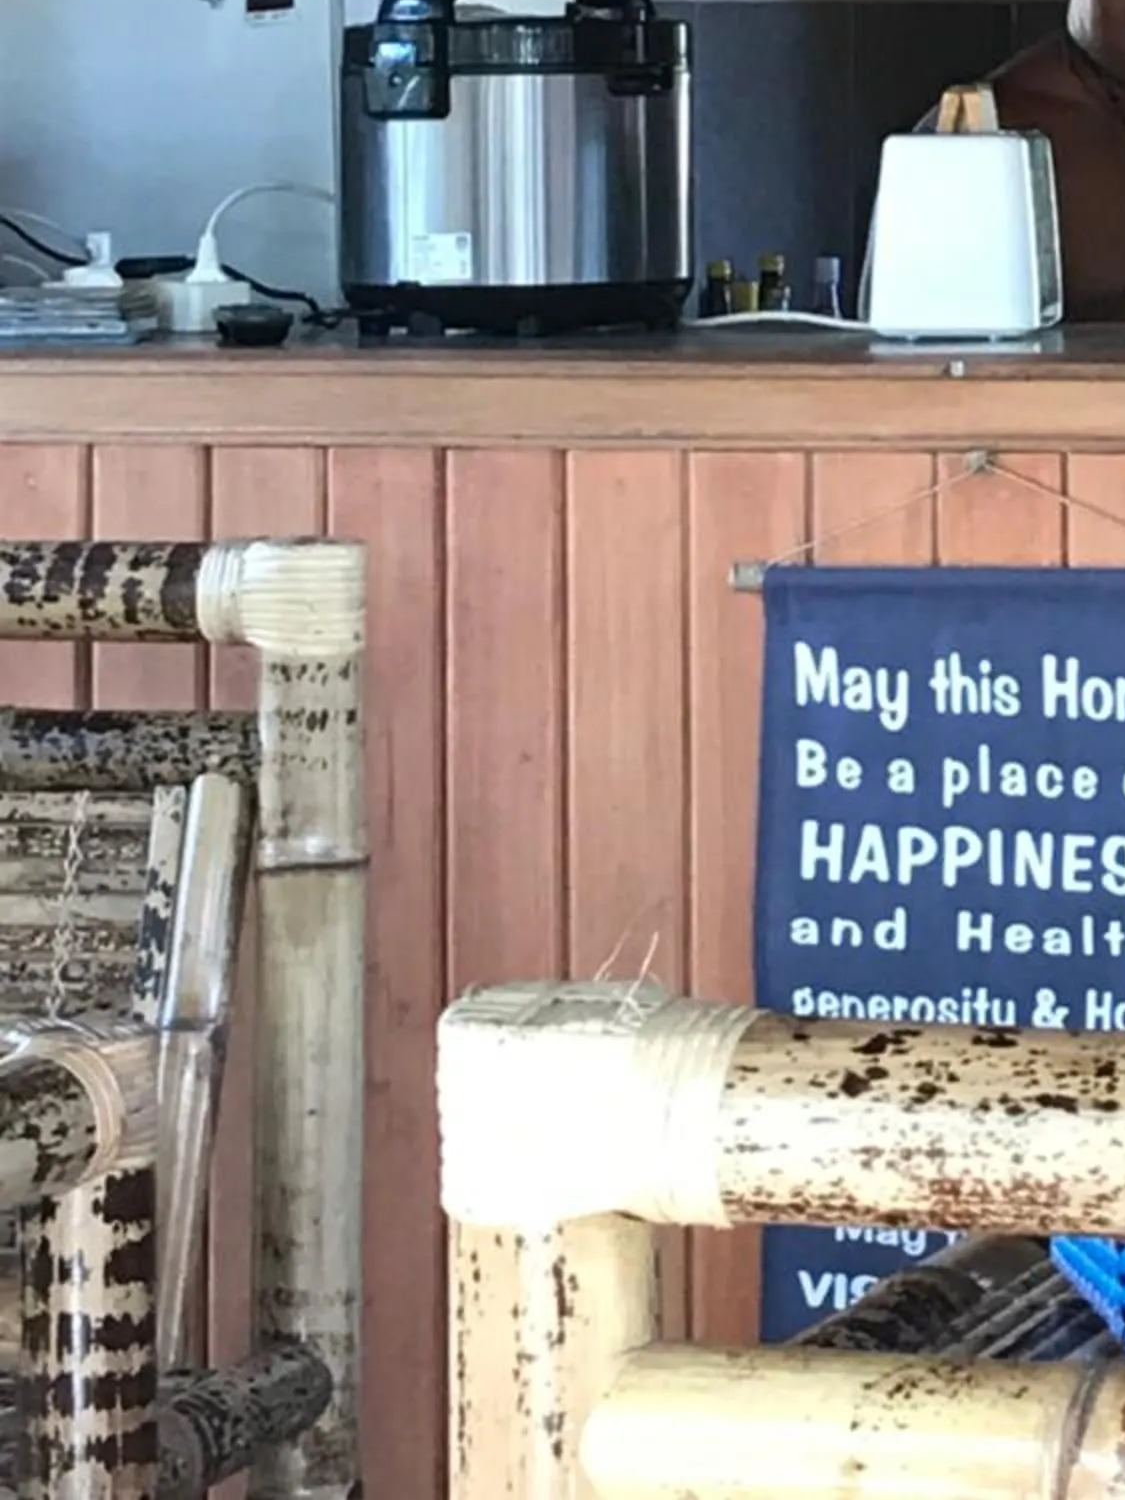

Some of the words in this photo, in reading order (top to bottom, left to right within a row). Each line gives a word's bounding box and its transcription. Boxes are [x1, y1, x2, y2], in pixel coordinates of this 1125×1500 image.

[794, 641, 909, 731] May
[929, 652, 1020, 717] this
[796, 739, 862, 790] Be
[888, 758, 914, 793] a
[942, 744, 1098, 808] place
[790, 907, 906, 950] and
[957, 911, 1125, 956] Healt
[1032, 987, 1069, 1029] &
[798, 1270, 879, 1310] VIS
